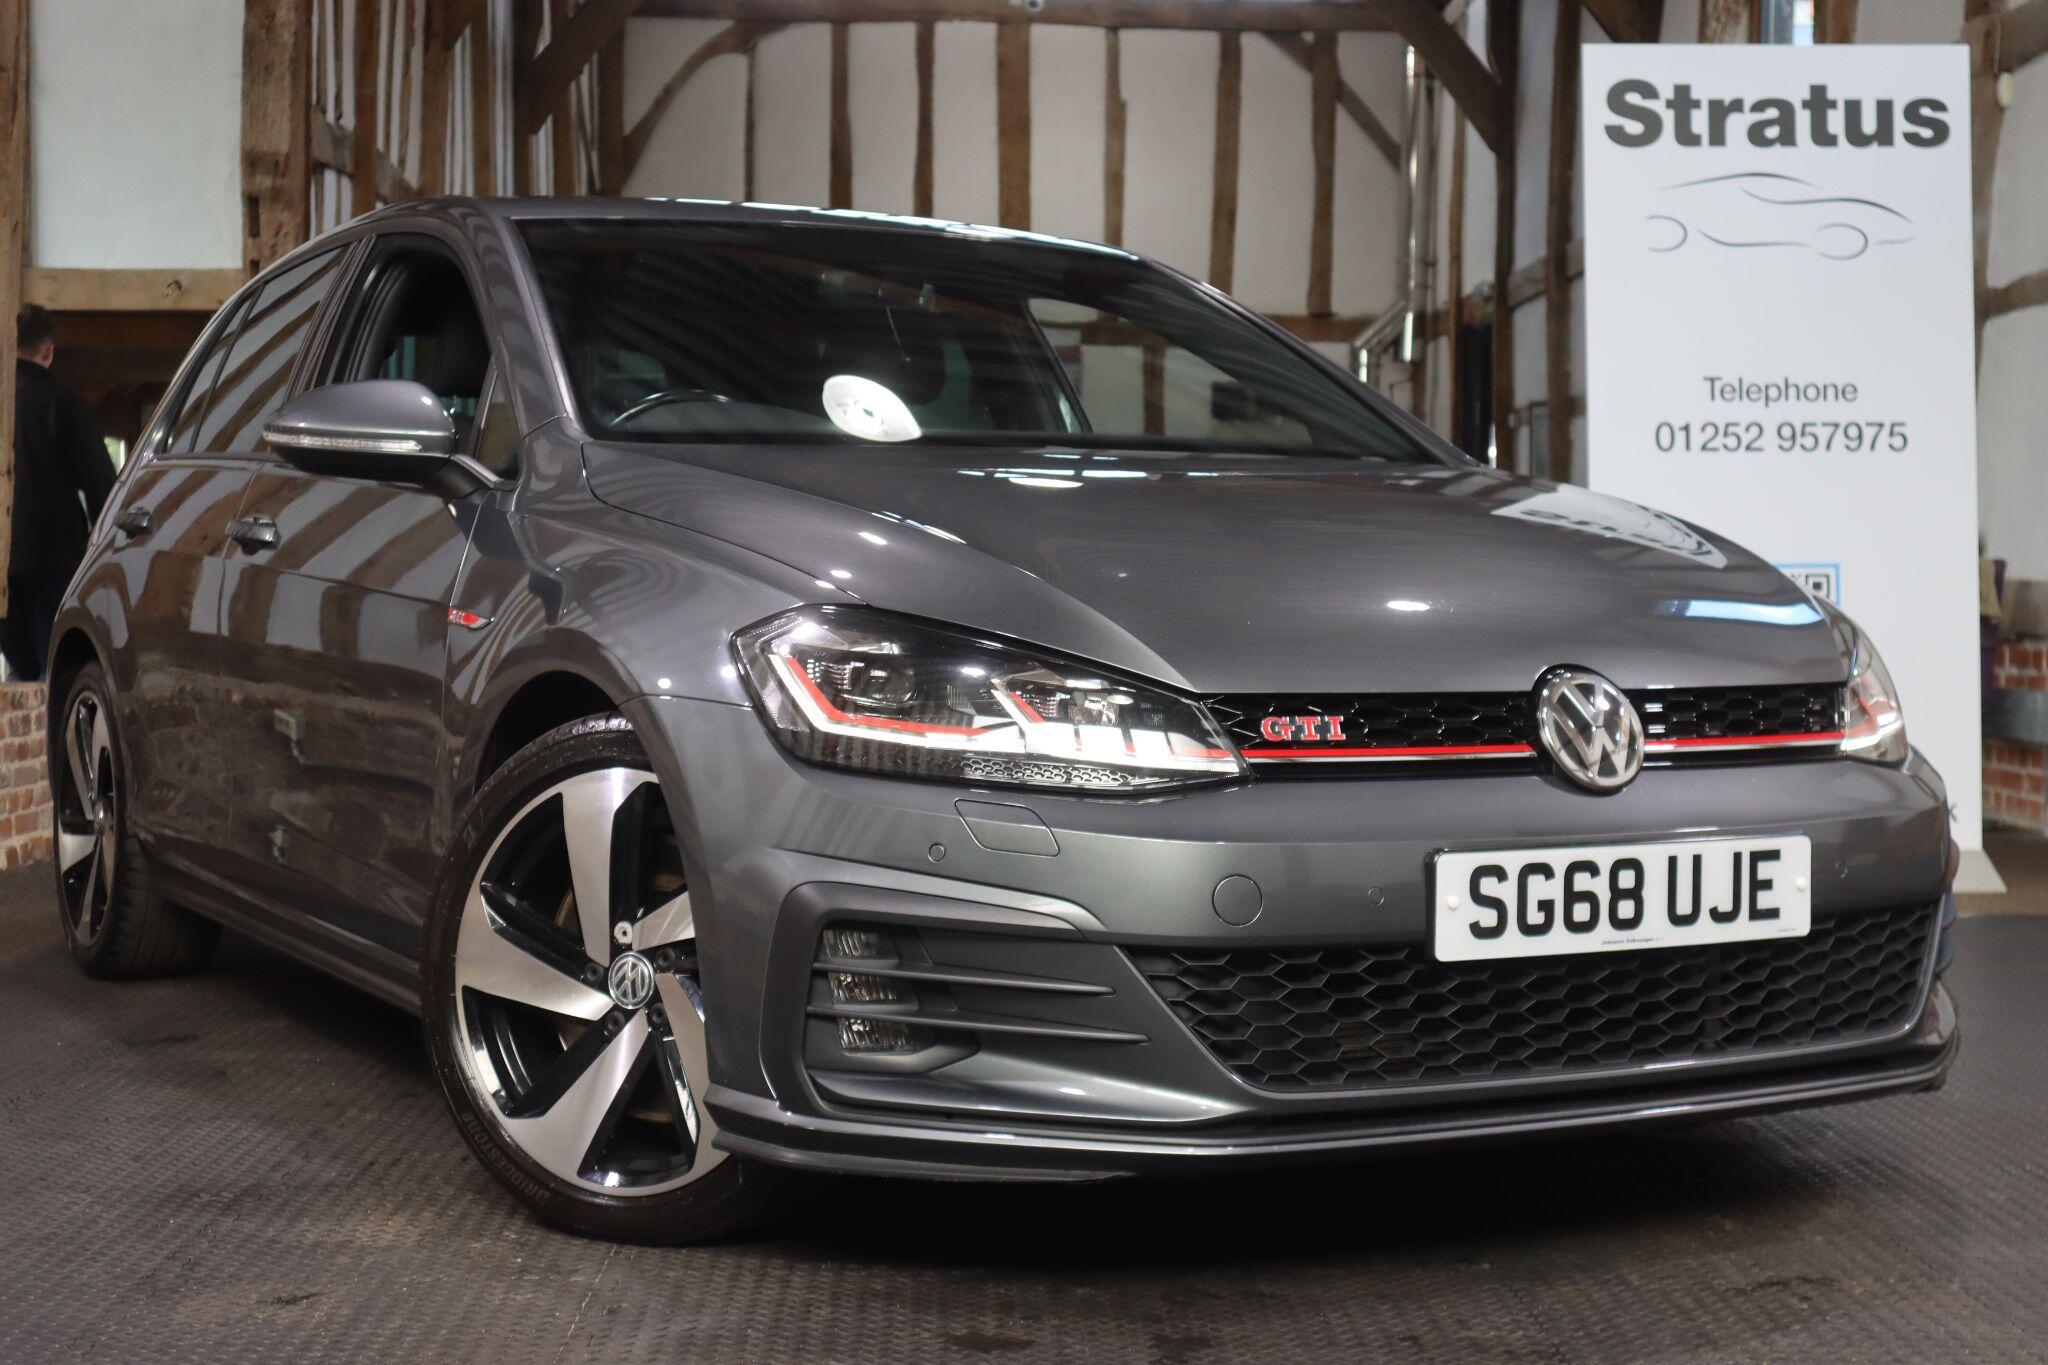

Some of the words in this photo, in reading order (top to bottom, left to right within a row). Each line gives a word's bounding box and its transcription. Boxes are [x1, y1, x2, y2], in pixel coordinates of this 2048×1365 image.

[1605, 79, 1950, 148] Stratus
[1703, 376, 1858, 408] Telephone
[1656, 422, 1764, 452] 01252
[1777, 422, 1909, 452] 957975
[1261, 715, 1346, 741] GTI
[1469, 858, 1644, 939] SG68
[1668, 849, 1781, 926] UJE
